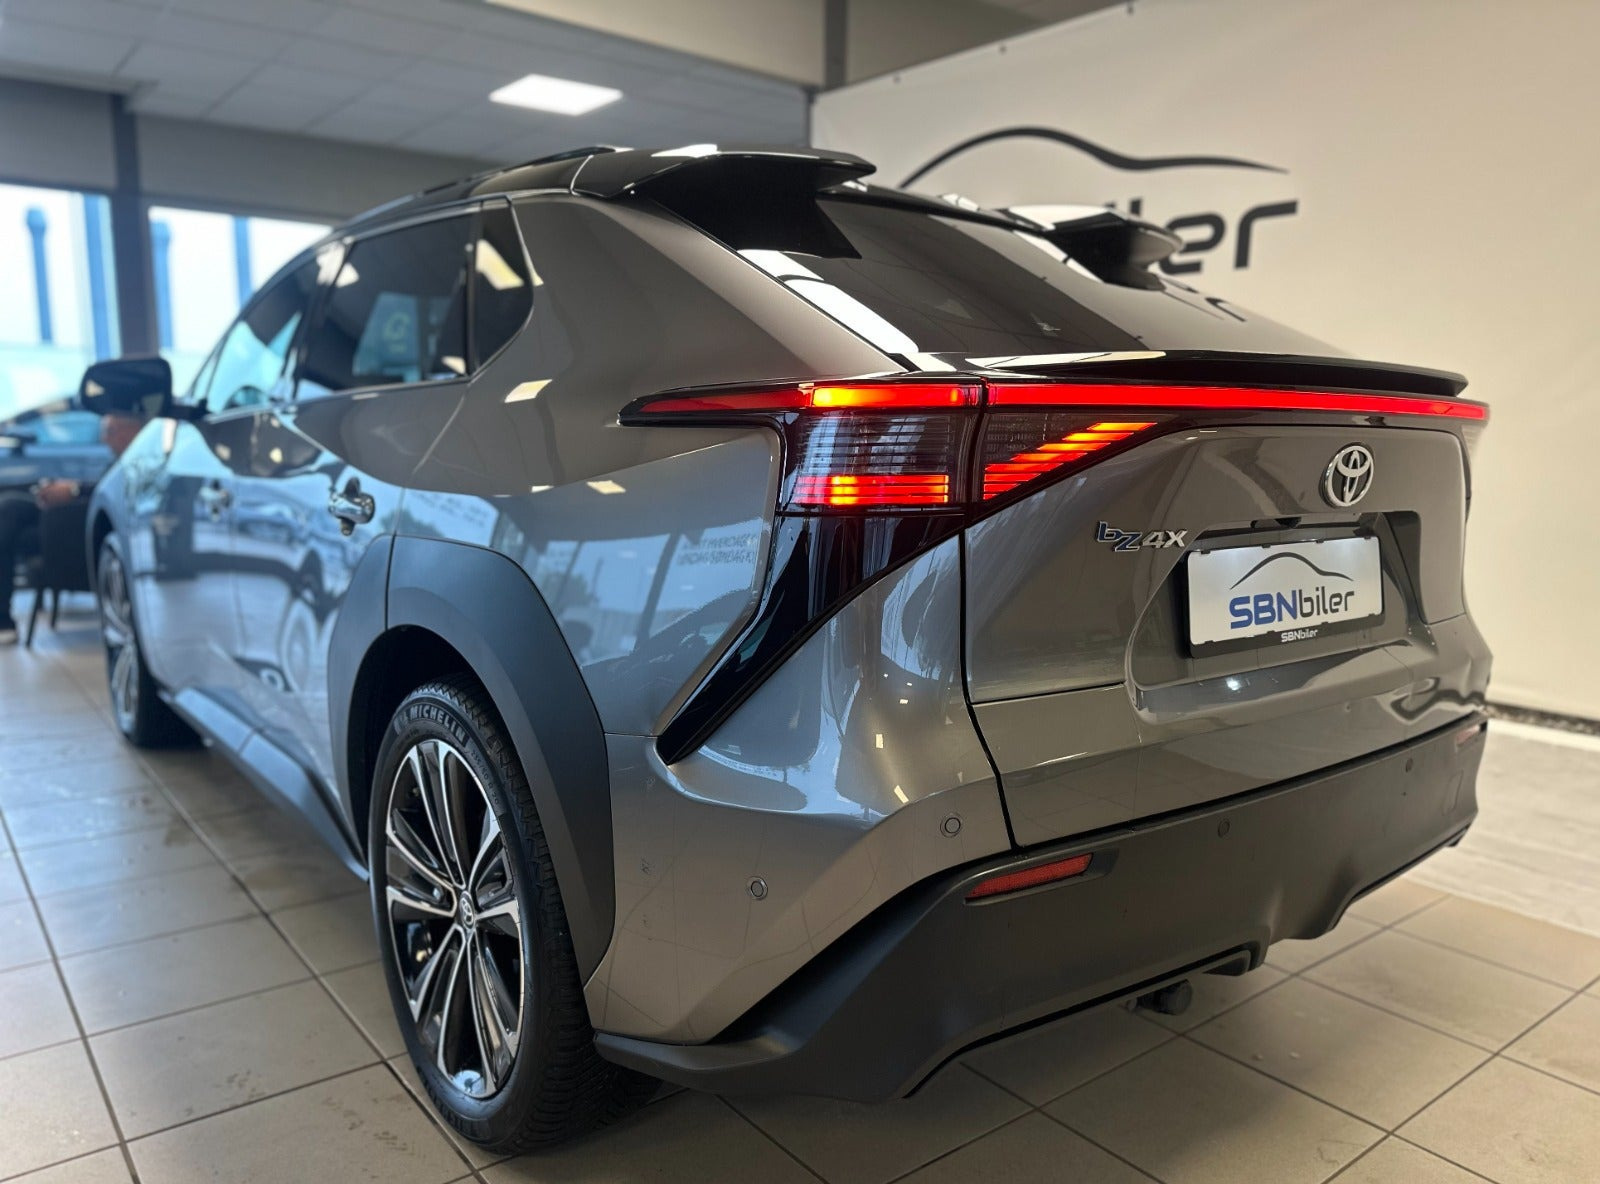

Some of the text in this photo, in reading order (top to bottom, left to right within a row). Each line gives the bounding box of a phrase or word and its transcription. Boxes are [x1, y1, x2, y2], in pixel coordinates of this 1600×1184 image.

[1229, 585, 1355, 629] SBNbiler
[1281, 630, 1318, 643] SBNbiler
[410, 705, 465, 743] MICHELIN
